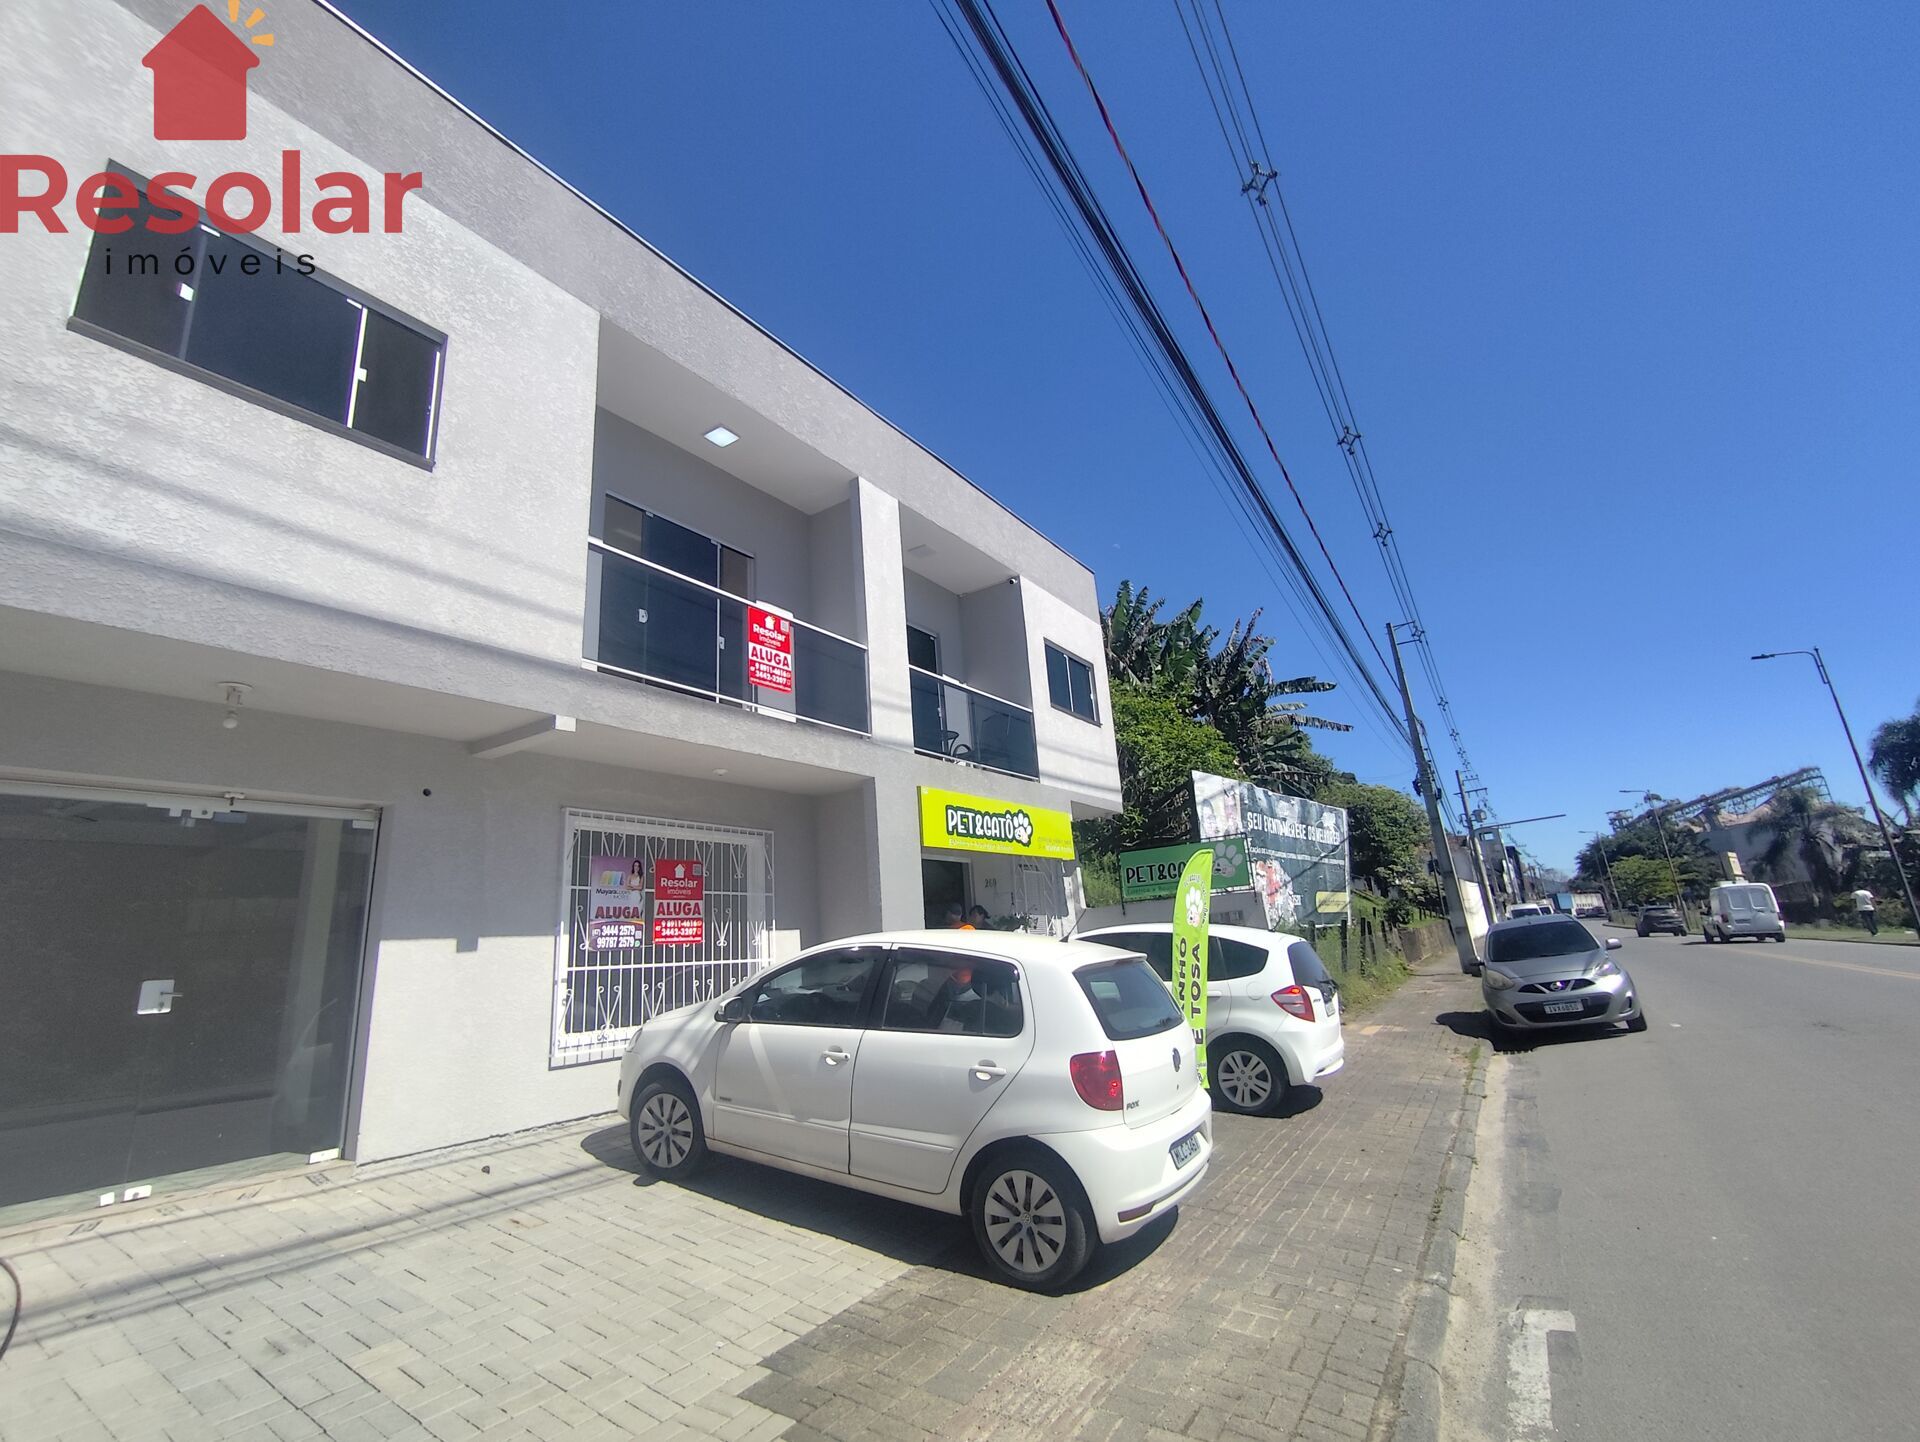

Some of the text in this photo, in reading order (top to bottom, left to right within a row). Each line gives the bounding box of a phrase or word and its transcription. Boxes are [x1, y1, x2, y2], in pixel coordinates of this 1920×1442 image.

[752, 623, 786, 642] Resolar
[751, 646, 790, 669] ALUGA
[947, 809, 1014, 840] PET&GATÔ
[1247, 811, 1262, 831] SEU
[660, 877, 698, 888] Resolar
[595, 906, 640, 919] ALUGA
[656, 902, 701, 916] ALUGA
[601, 924, 618, 936] 3444
[619, 924, 636, 936] 2579
[597, 936, 635, 949] 99787 2579
[1191, 943, 1204, 1045] E TOSA
[1126, 1100, 1140, 1110] FOX
